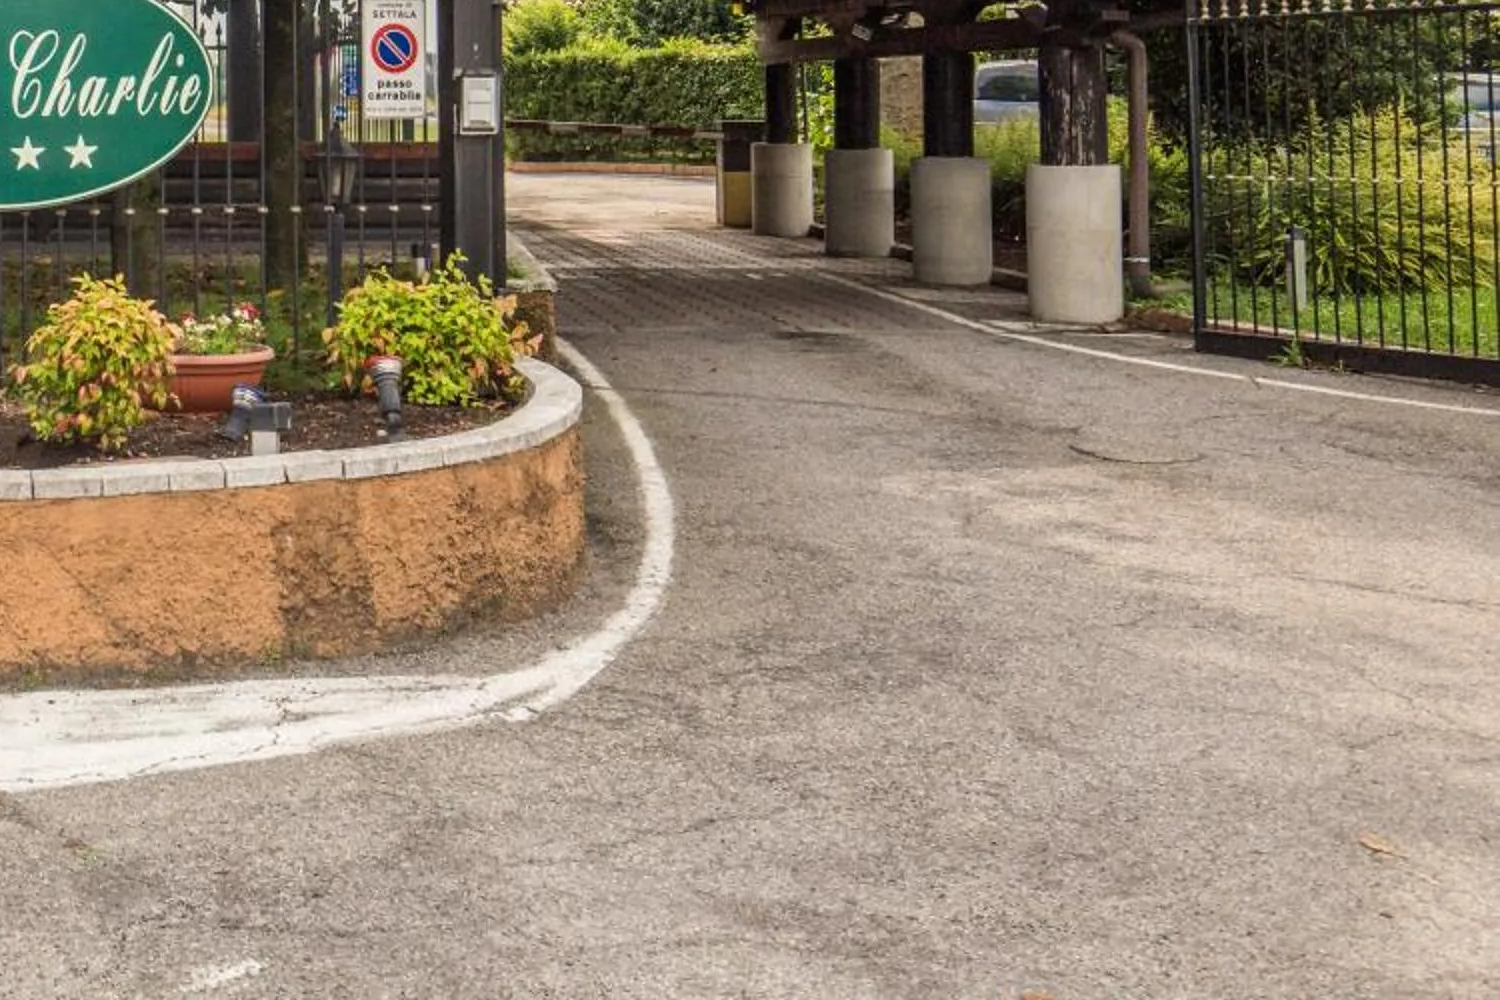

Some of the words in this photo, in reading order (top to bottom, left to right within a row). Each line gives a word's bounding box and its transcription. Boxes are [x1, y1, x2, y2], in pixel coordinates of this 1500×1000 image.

[372, 9, 417, 19] SETTALA
[9, 29, 202, 119] Charlie
[377, 79, 413, 90] passo
[367, 90, 421, 101] carrabile
